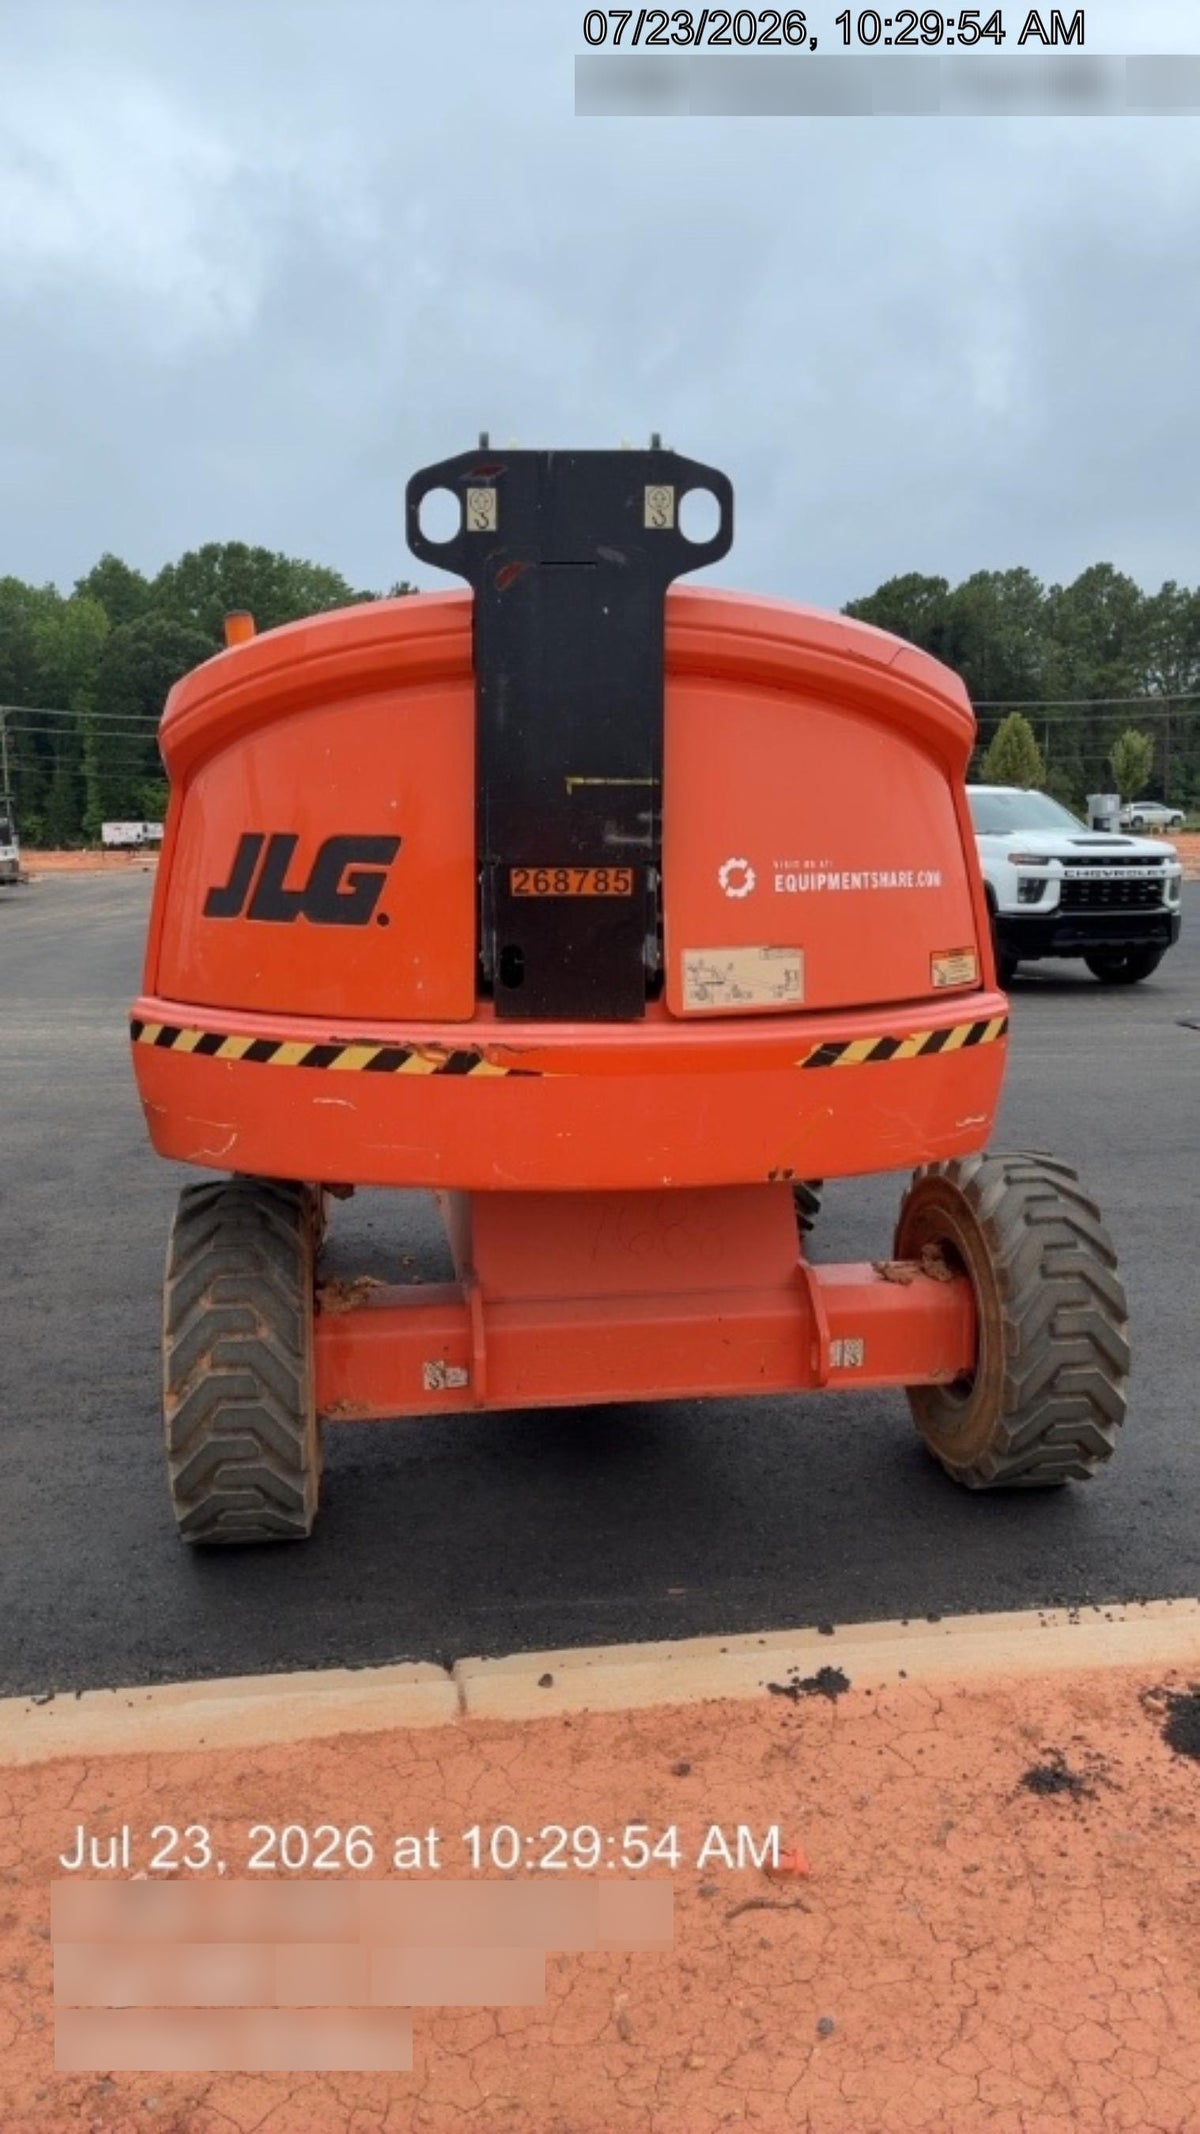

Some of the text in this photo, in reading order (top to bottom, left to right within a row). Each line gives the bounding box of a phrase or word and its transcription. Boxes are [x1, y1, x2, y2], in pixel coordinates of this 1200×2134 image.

[513, 869, 631, 894] 268785
[774, 871, 941, 892] EQUIPMENTSHARE.COM
[1063, 869, 1167, 878] CHEVROLET
